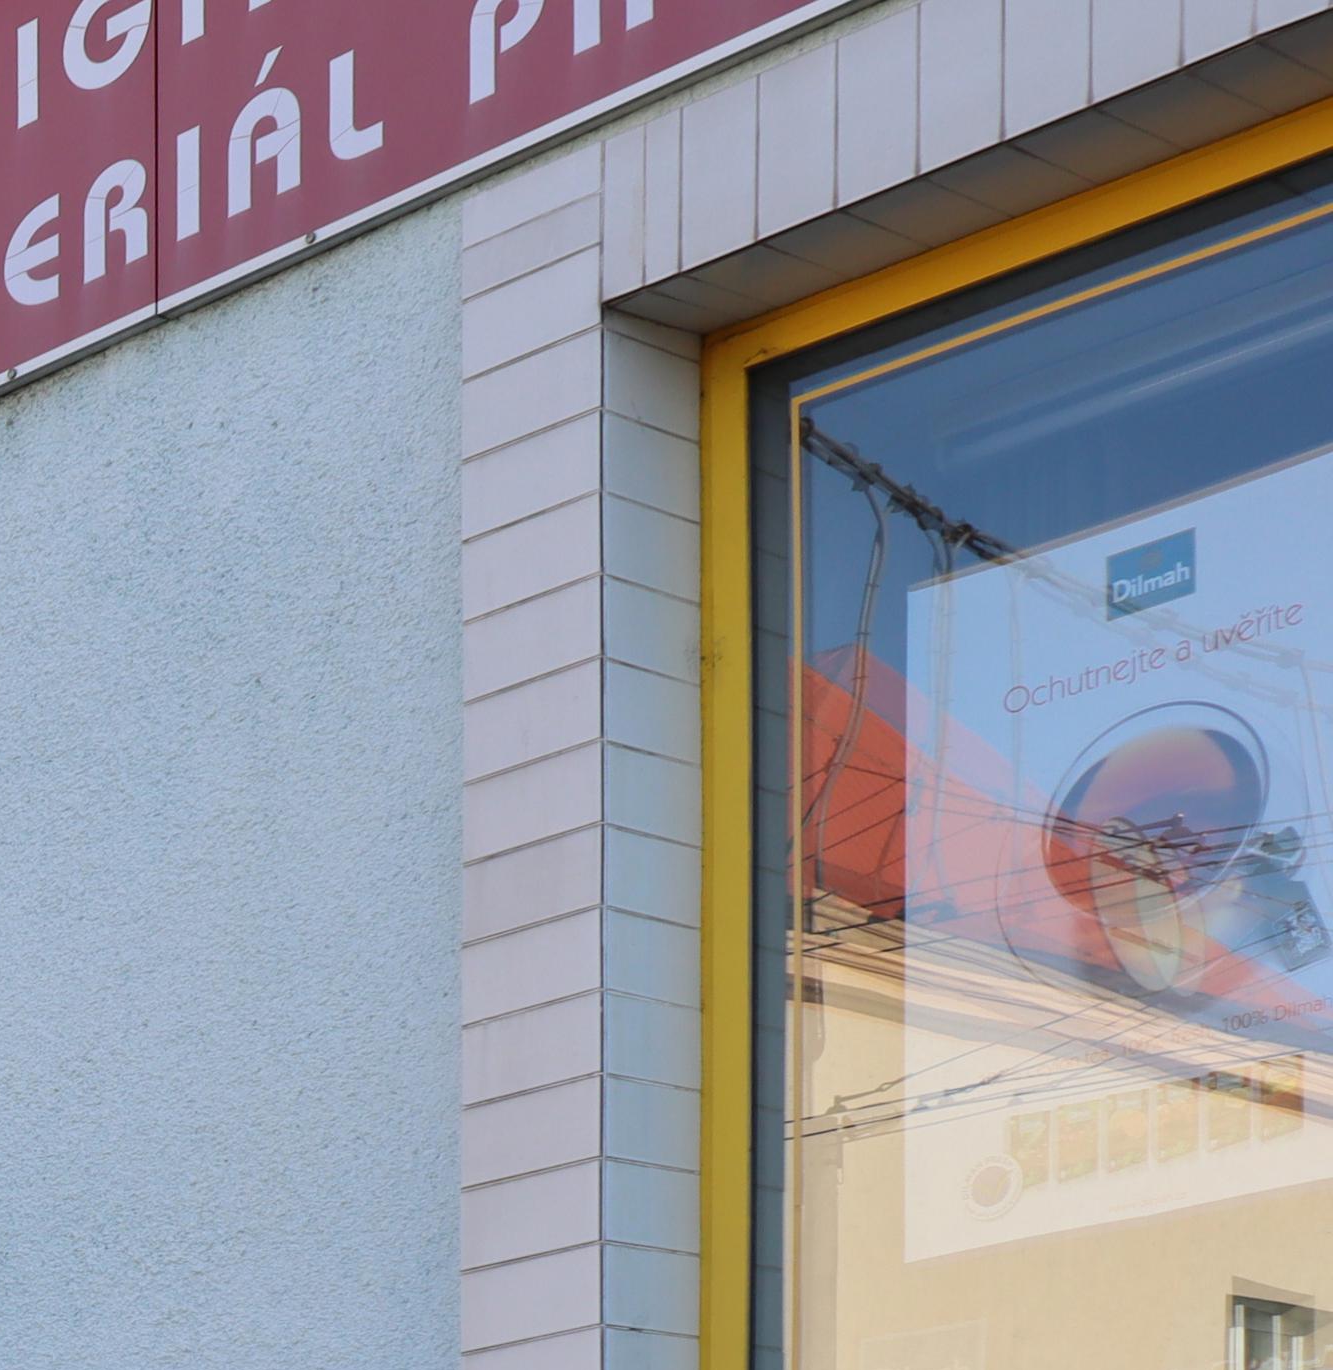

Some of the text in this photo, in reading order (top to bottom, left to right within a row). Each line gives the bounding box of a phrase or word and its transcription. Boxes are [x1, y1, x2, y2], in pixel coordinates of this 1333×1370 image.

[1111, 561, 1191, 604] Dilmah
[1002, 602, 1303, 713] Ochutnejte a uvěříte
